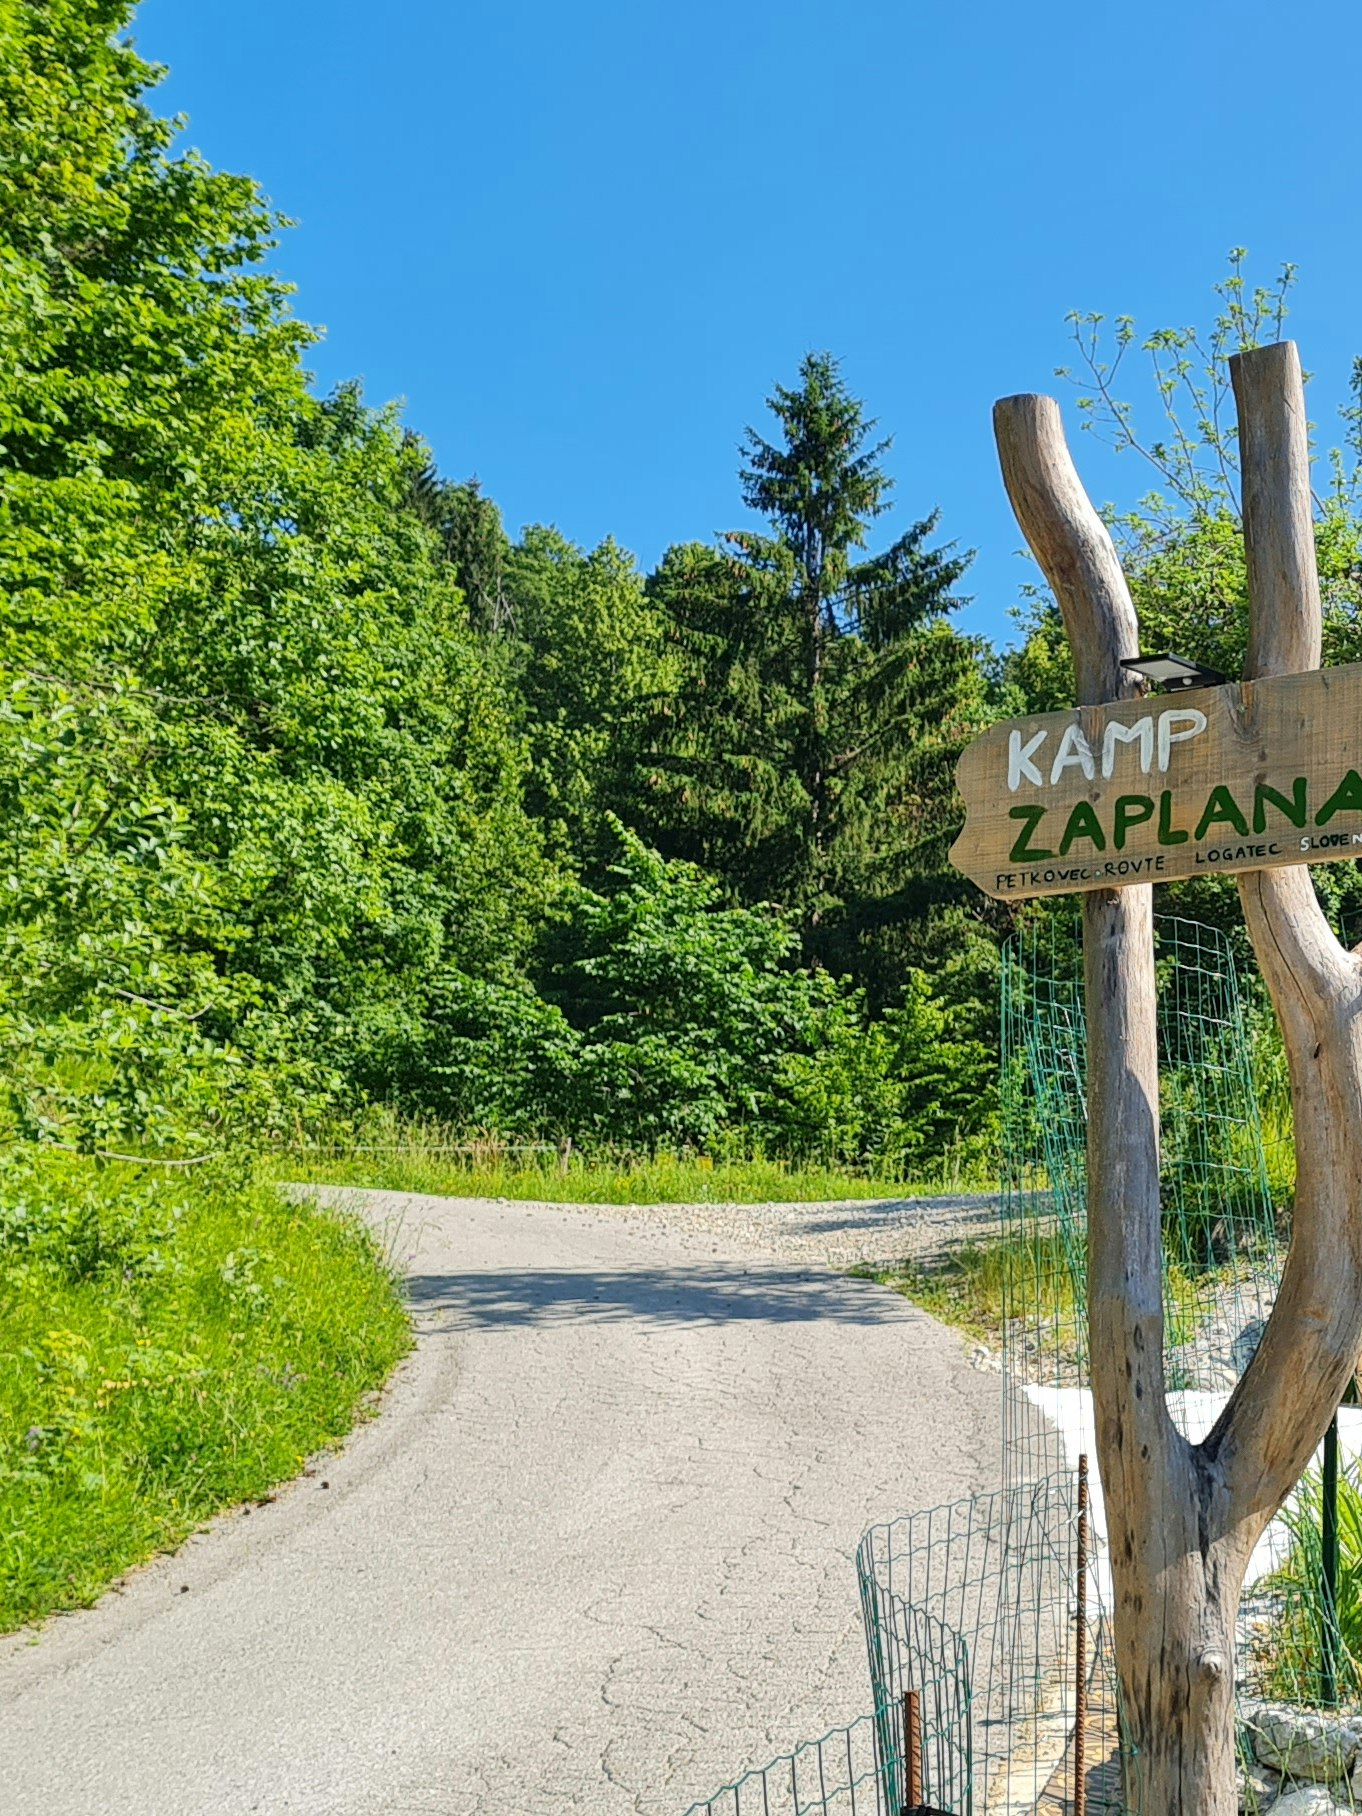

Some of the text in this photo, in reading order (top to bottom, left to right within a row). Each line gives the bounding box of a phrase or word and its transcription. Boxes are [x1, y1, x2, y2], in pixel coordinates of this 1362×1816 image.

[1007, 709, 1207, 792] KAMP
[996, 868, 1091, 890] PETKOVEC
[1103, 855, 1165, 876] ROVTE
[1195, 842, 1282, 864] LOGATEC
